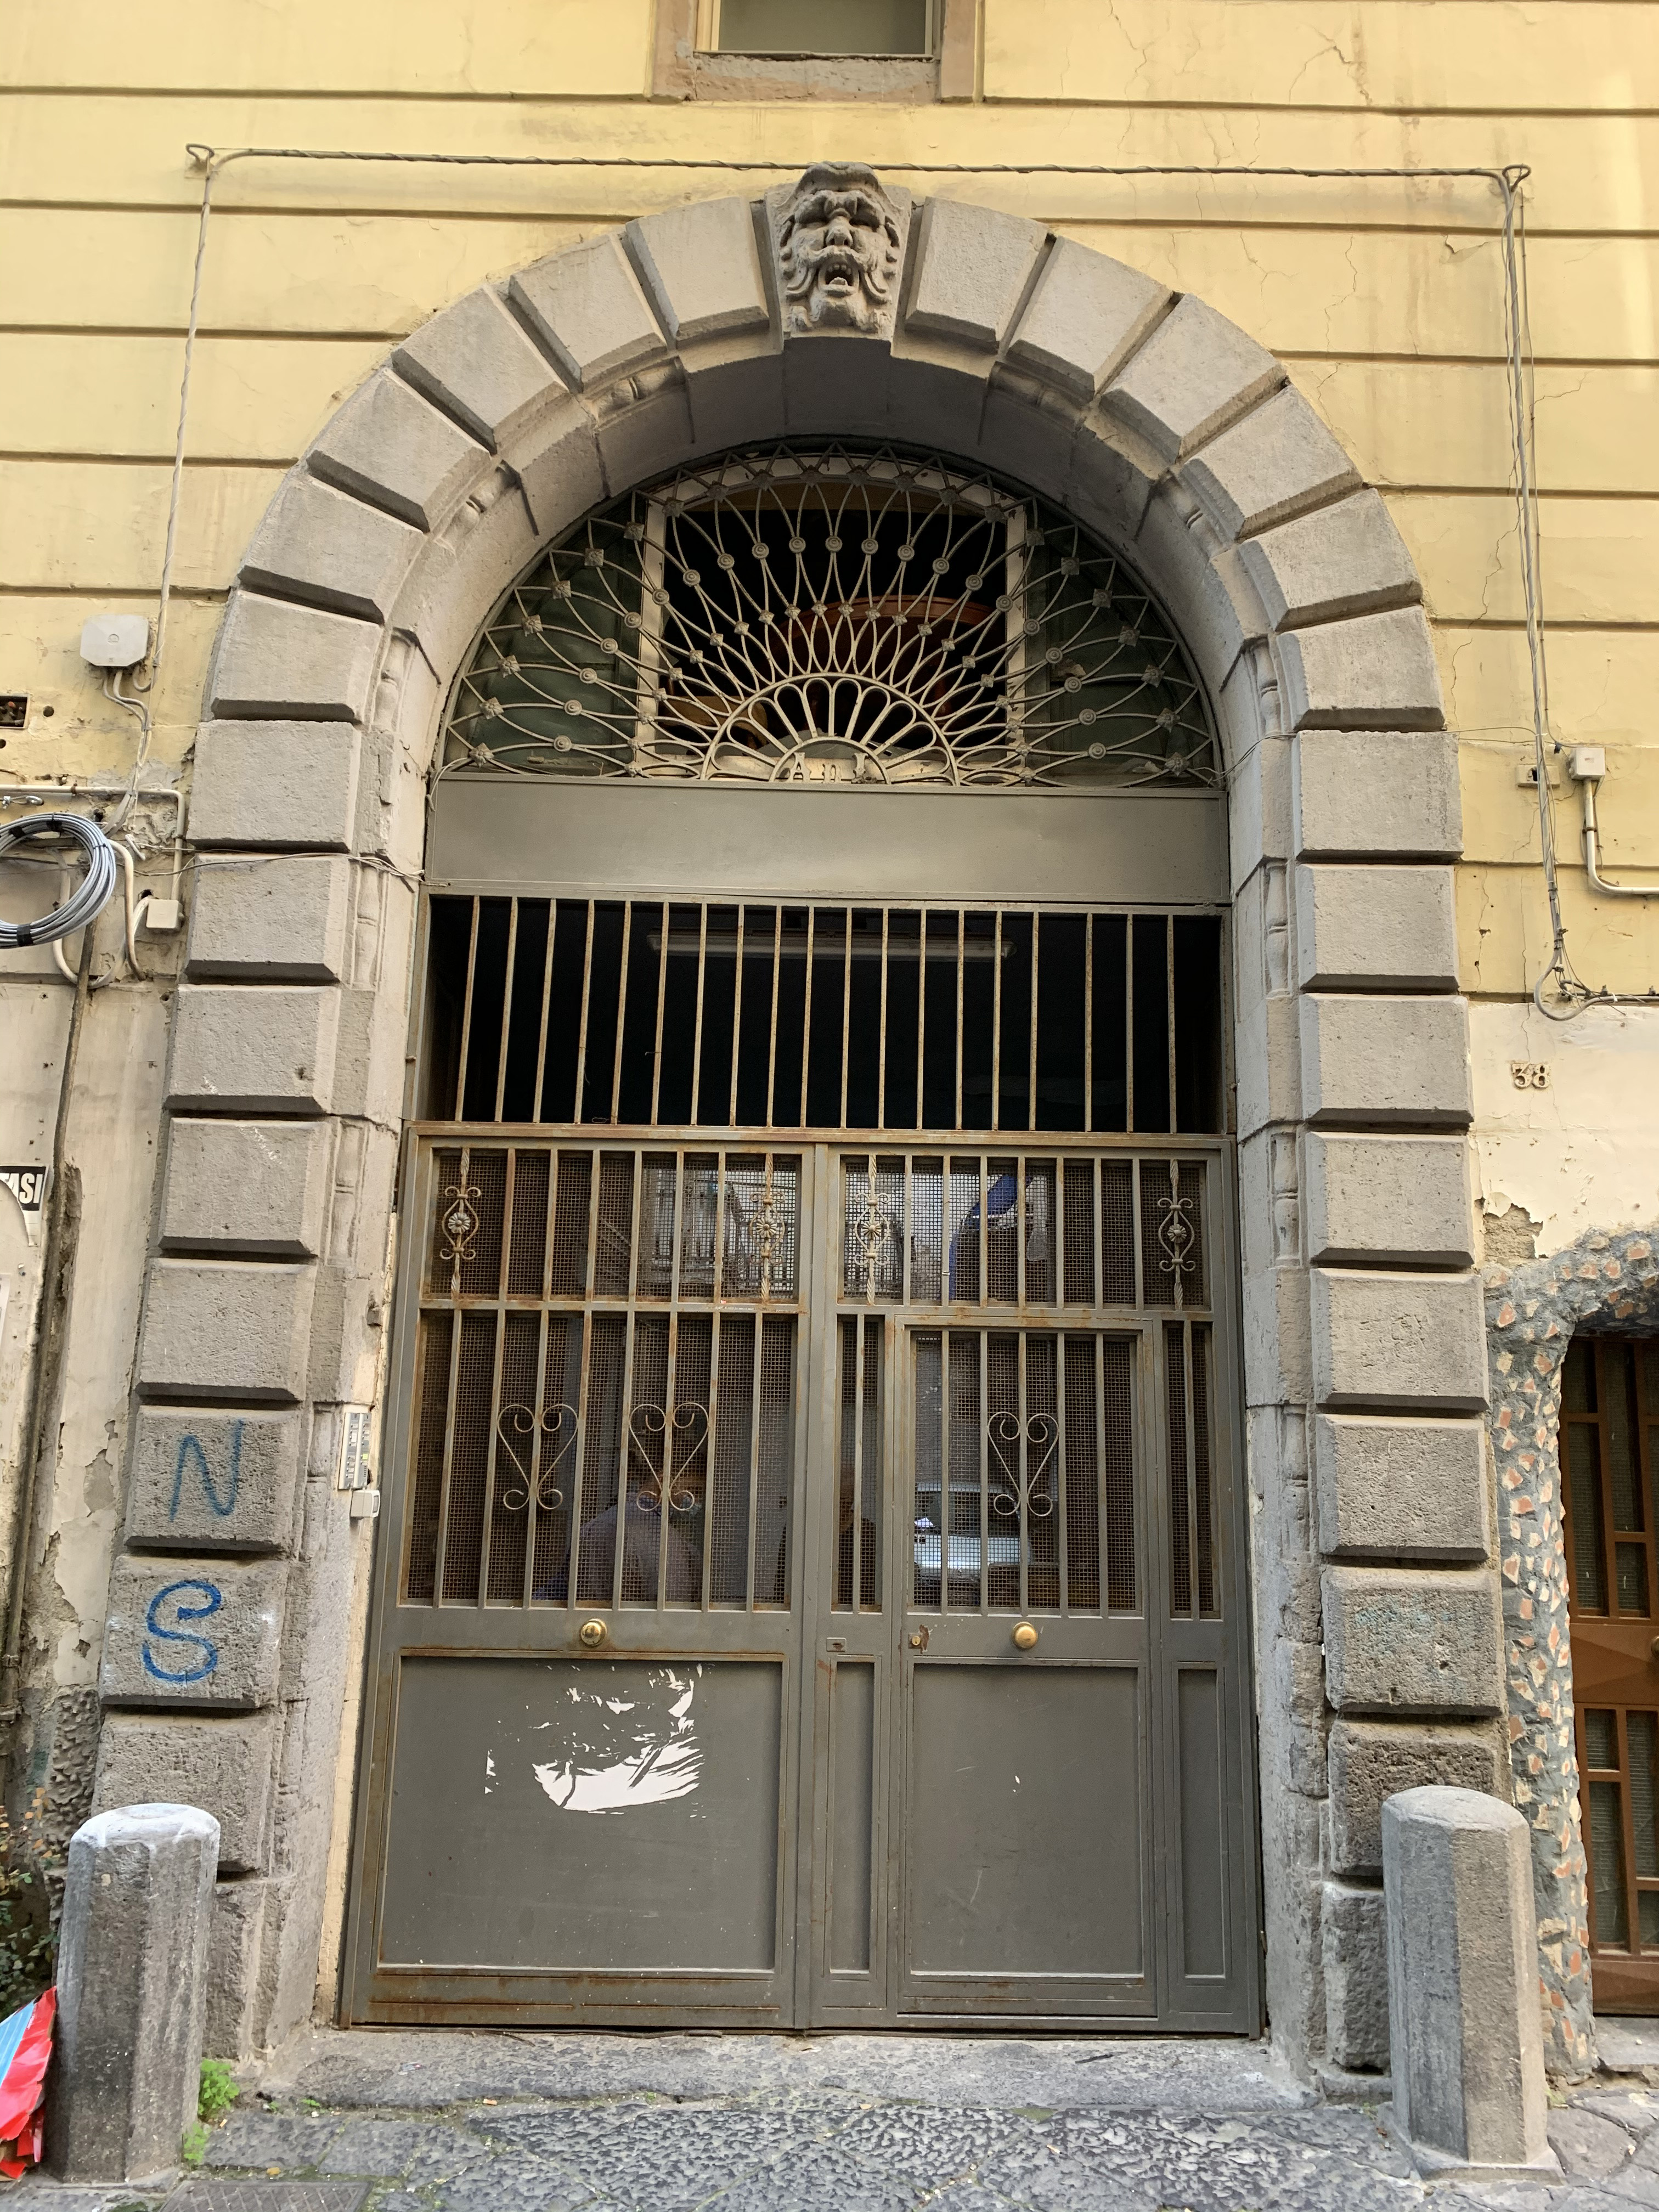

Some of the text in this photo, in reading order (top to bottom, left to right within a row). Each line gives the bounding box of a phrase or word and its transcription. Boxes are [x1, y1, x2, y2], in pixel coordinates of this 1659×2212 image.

[1512, 1063, 1550, 1088] 38
[169, 1418, 246, 1522] N
[142, 1579, 222, 1683] S
